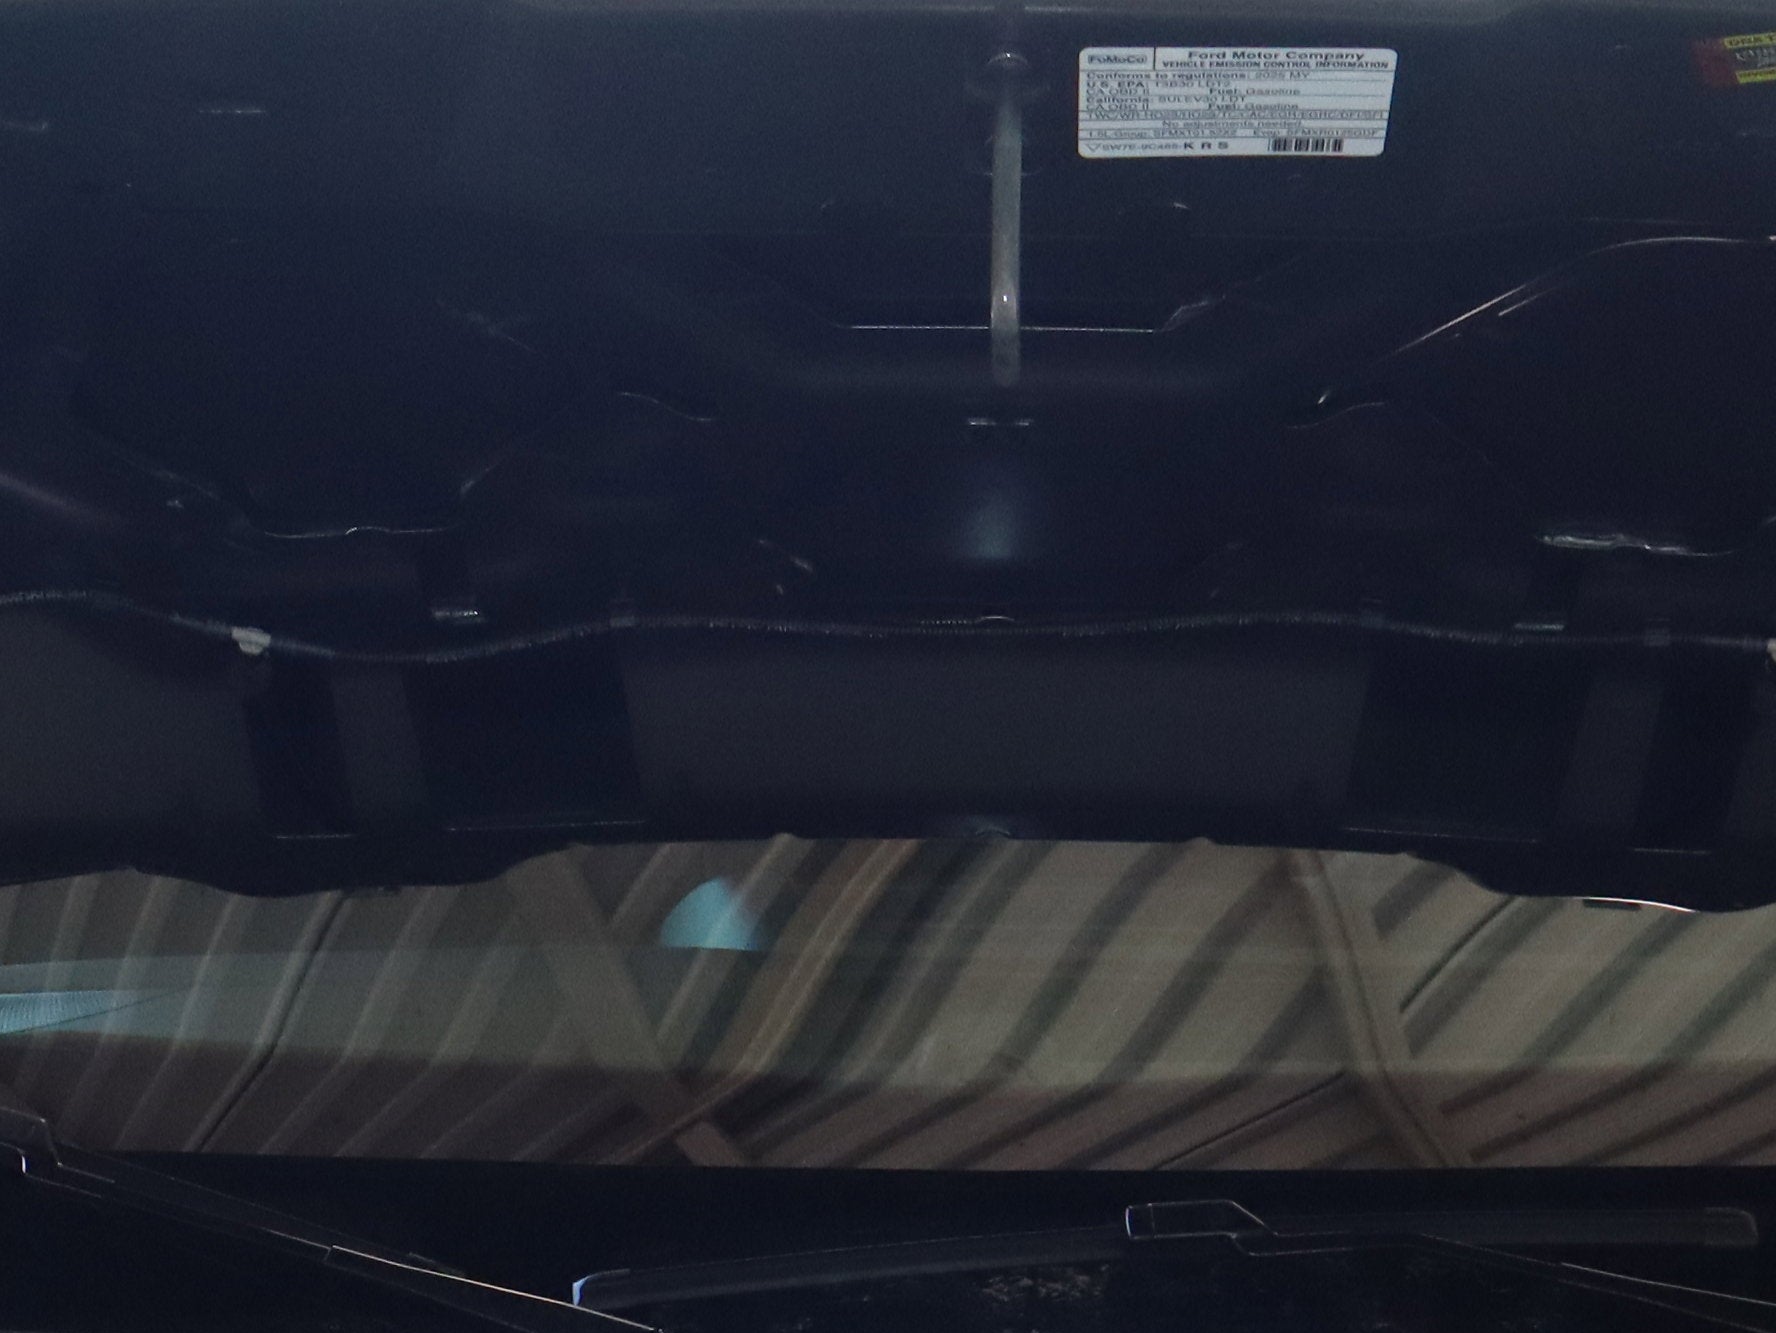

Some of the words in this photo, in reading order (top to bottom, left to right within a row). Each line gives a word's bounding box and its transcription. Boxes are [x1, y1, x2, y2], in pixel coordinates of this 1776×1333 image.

[1087, 54, 1147, 65] FoMoCo
[1188, 51, 1226, 60] Ford
[1232, 51, 1279, 60] Motor
[1285, 51, 1365, 61] Company
[1162, 61, 1206, 69] VEHICLE
[1209, 61, 1260, 69] EMISSION
[1263, 61, 1312, 69] CONTROL
[1315, 61, 1389, 69] INFORMATION
[1086, 72, 1151, 80] Conforms
[1155, 72, 1168, 80] to
